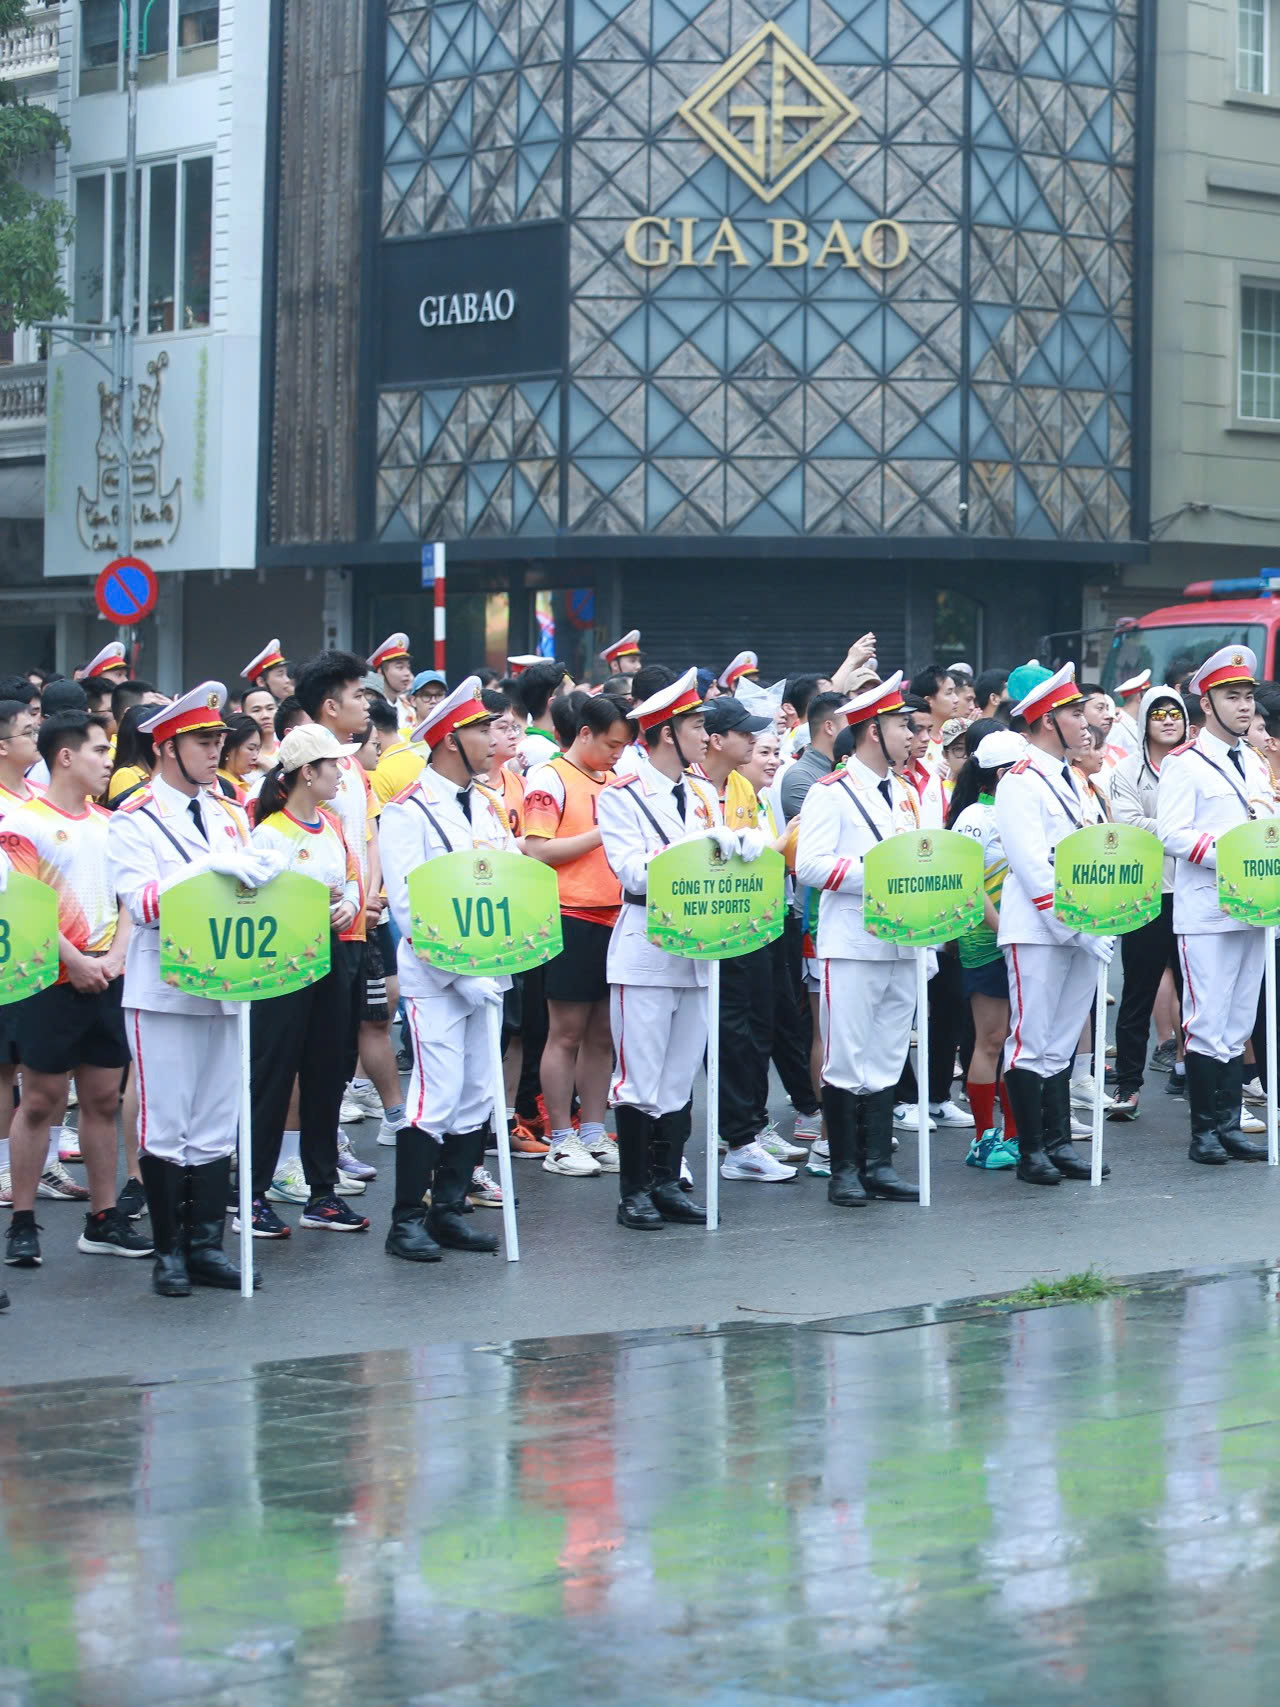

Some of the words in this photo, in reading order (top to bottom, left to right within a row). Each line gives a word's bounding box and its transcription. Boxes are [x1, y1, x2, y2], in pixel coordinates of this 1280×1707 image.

[624, 216, 751, 267] GIA
[766, 218, 910, 269] BAO
[419, 288, 515, 327] GIABAO
[1072, 859, 1116, 885] KHÁCH
[1118, 859, 1144, 885] MỜI
[1243, 858, 1280, 880] TRỌNG
[672, 877, 700, 895] CÔNG
[703, 879, 715, 894] TY
[718, 873, 733, 894] CỔ
[887, 874, 963, 895] VIETCOMBANK
[452, 896, 511, 938] V01
[683, 900, 709, 916] NEW
[711, 899, 751, 915] SPORTS
[209, 915, 278, 960] V02
